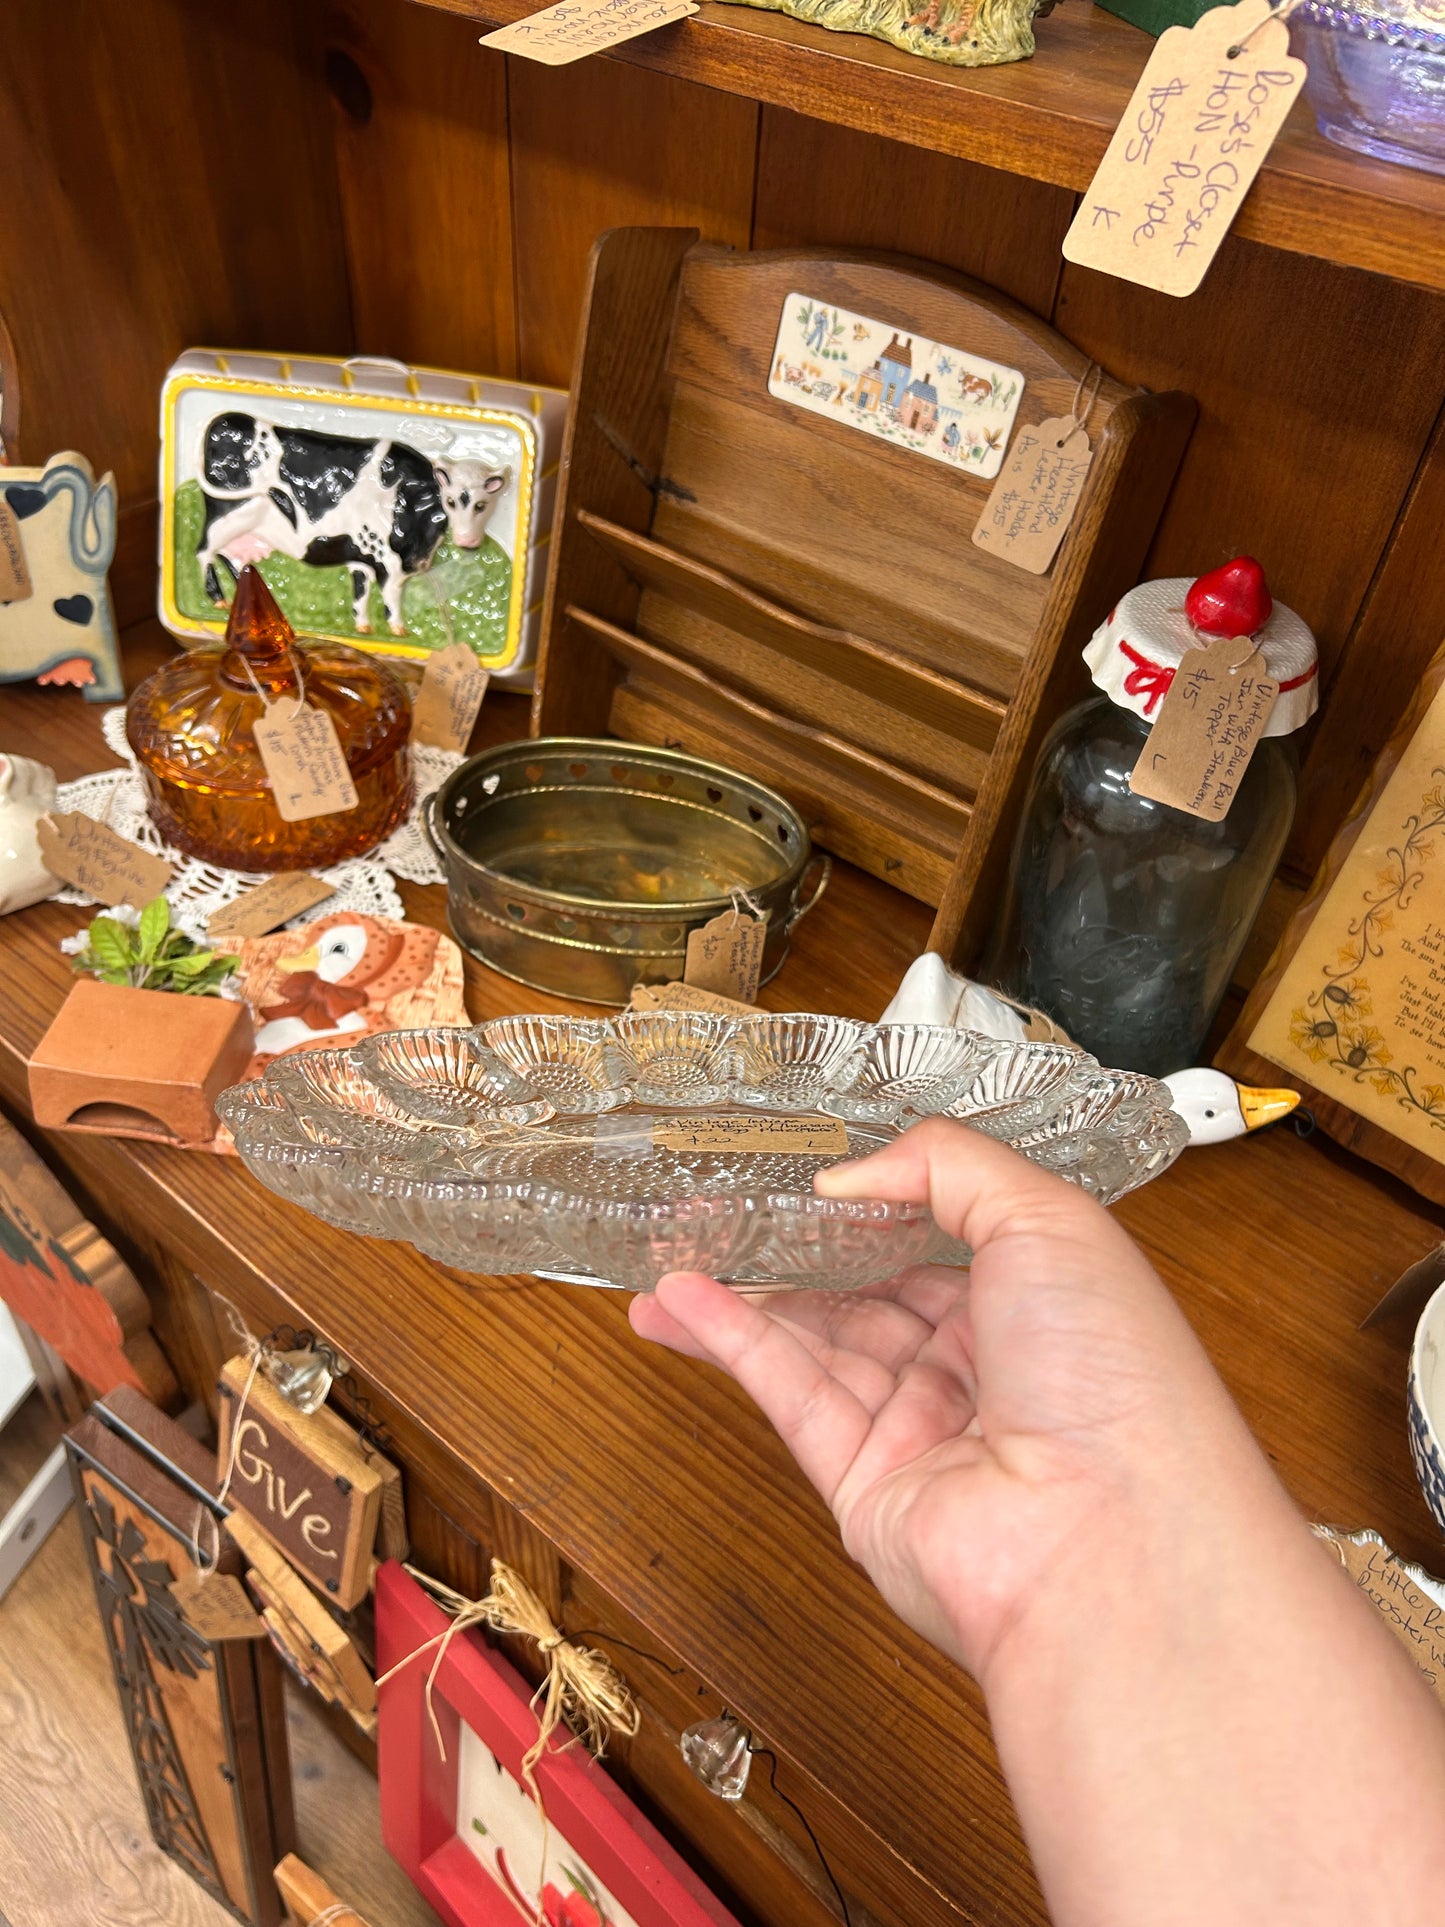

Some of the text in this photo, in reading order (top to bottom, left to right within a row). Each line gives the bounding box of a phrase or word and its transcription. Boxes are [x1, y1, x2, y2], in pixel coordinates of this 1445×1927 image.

[515, 25, 541, 34] K
[564, 18, 590, 30] no
[592, 18, 619, 31] no
[617, 21, 644, 33] no
[1194, 70, 1249, 132] HON
[1125, 78, 1190, 165] $55
[1092, 206, 1121, 230] K
[1029, 449, 1058, 492] Letter
[1047, 463, 1089, 528] Vintage
[1183, 668, 1215, 709] $15
[1238, 678, 1254, 711] Jar
[1206, 692, 1232, 746] Topper
[1214, 684, 1273, 810] Vintage Blue Ball
[1153, 753, 1167, 771] L
[1425, 923, 1432, 932] I
[1401, 938, 1416, 954] The
[1417, 935, 1441, 951] And
[1400, 975, 1440, 1002] I've had
[1400, 990, 1421, 1007] Just
[1394, 1014, 1406, 1028] To
[1409, 1028, 1423, 1038] see
[1401, 1005, 1436, 1031] But I'll
[1368, 1550, 1423, 1610] Little
